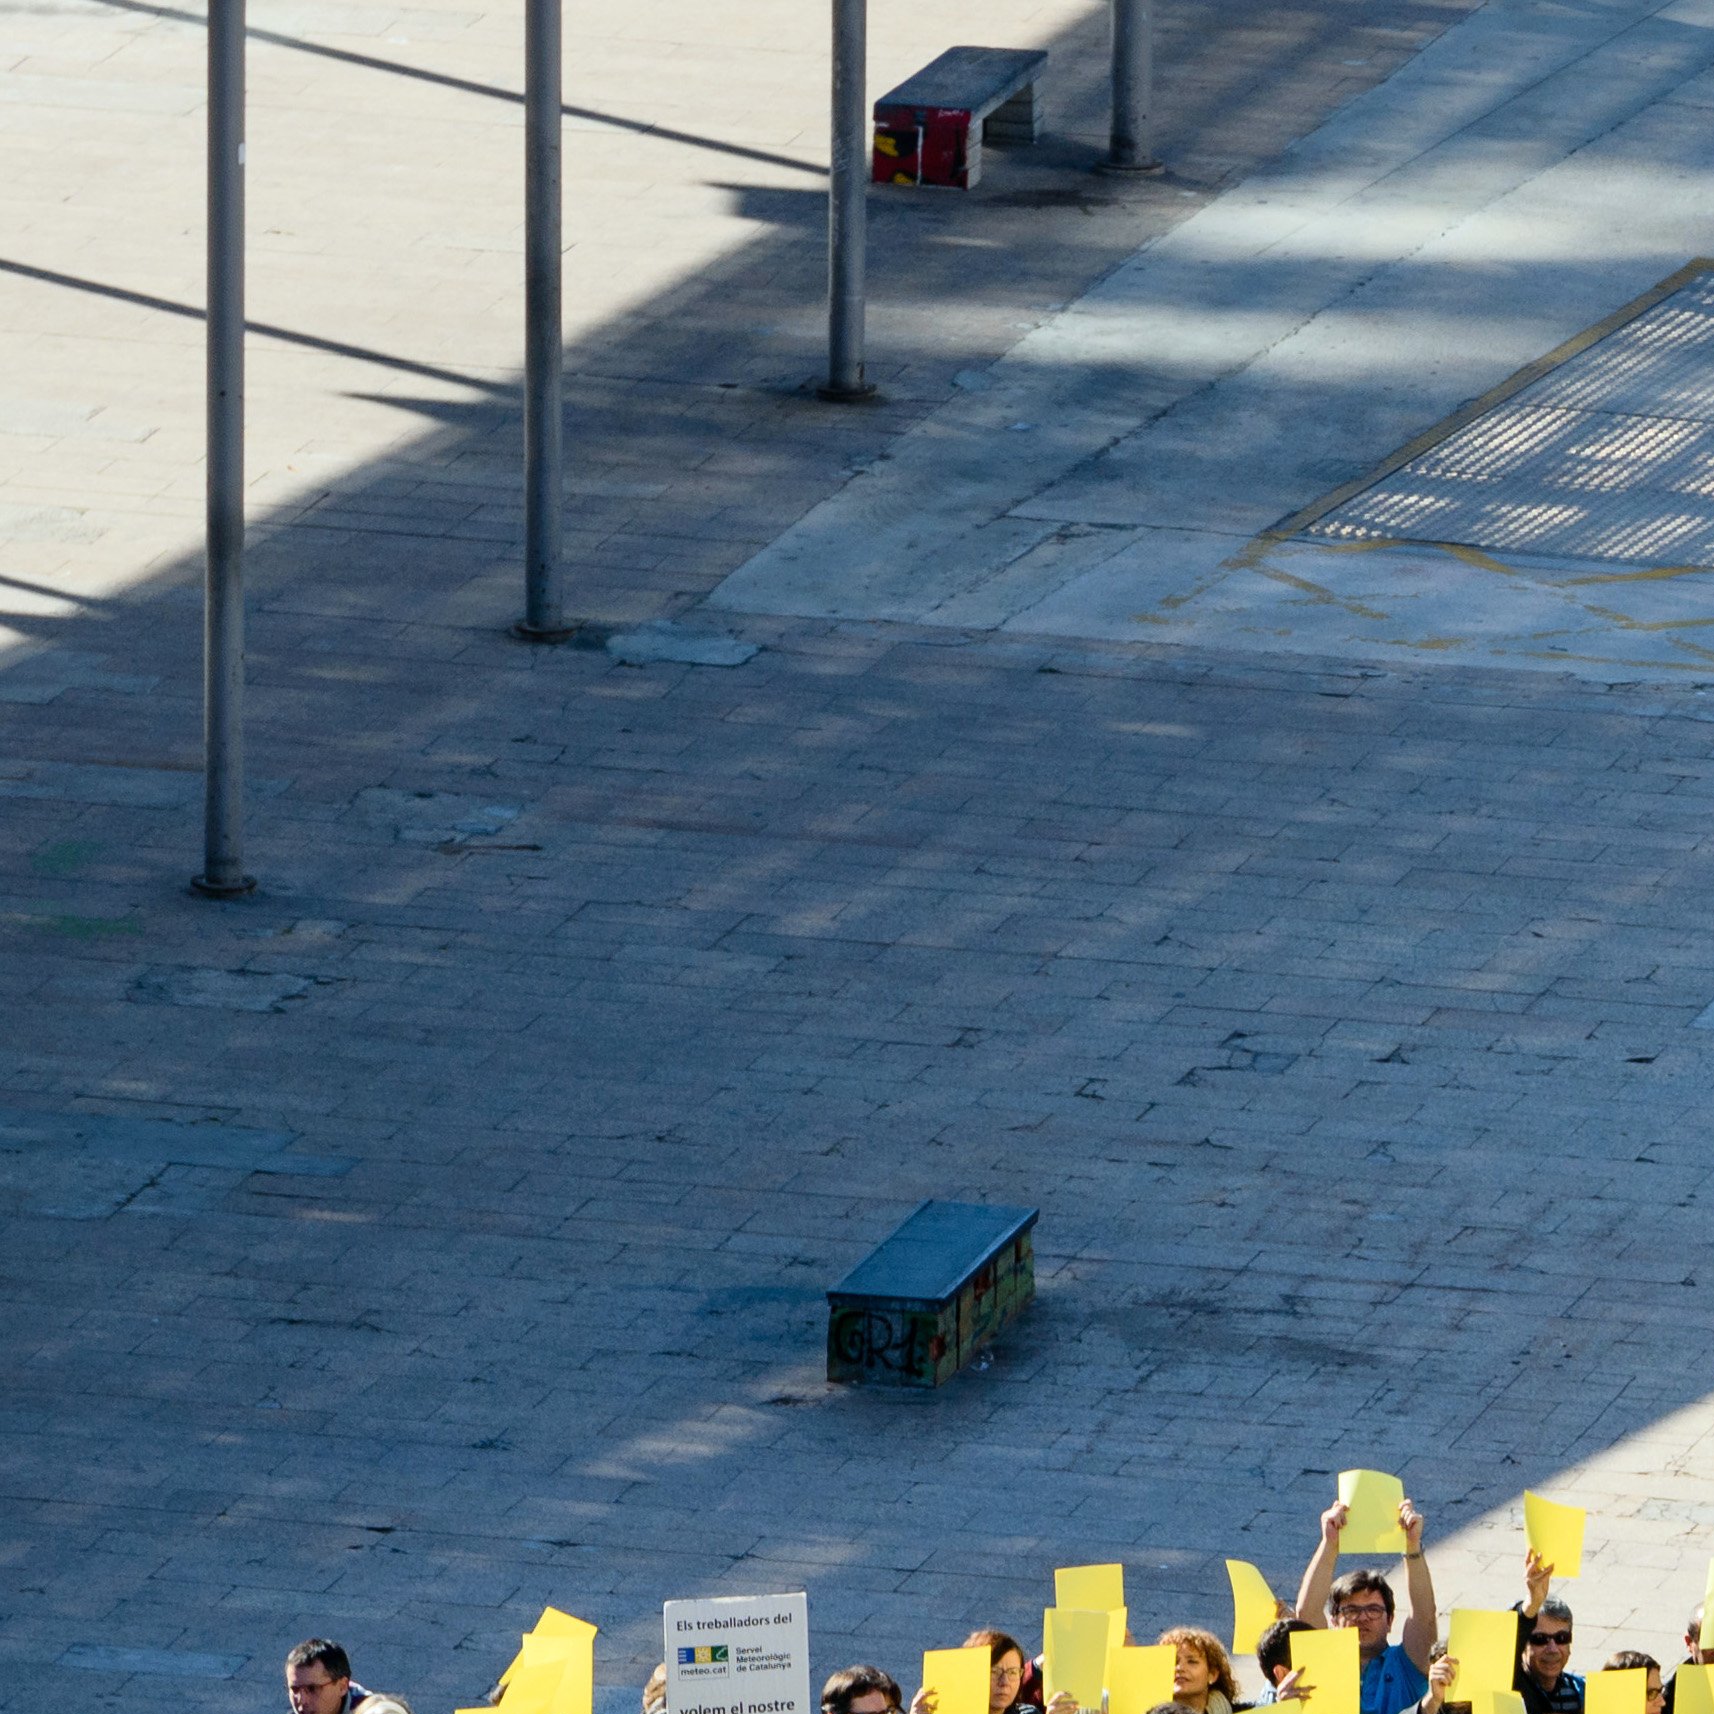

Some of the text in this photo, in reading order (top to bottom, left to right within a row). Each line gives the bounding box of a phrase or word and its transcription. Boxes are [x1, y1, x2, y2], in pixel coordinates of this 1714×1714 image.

[676, 1612, 792, 1632] Els treballadors del
[681, 1666, 727, 1676] meteo.cat
[736, 1661, 792, 1673] de Catalunya
[730, 1701, 743, 1714] el
[748, 1700, 795, 1714] nostre
